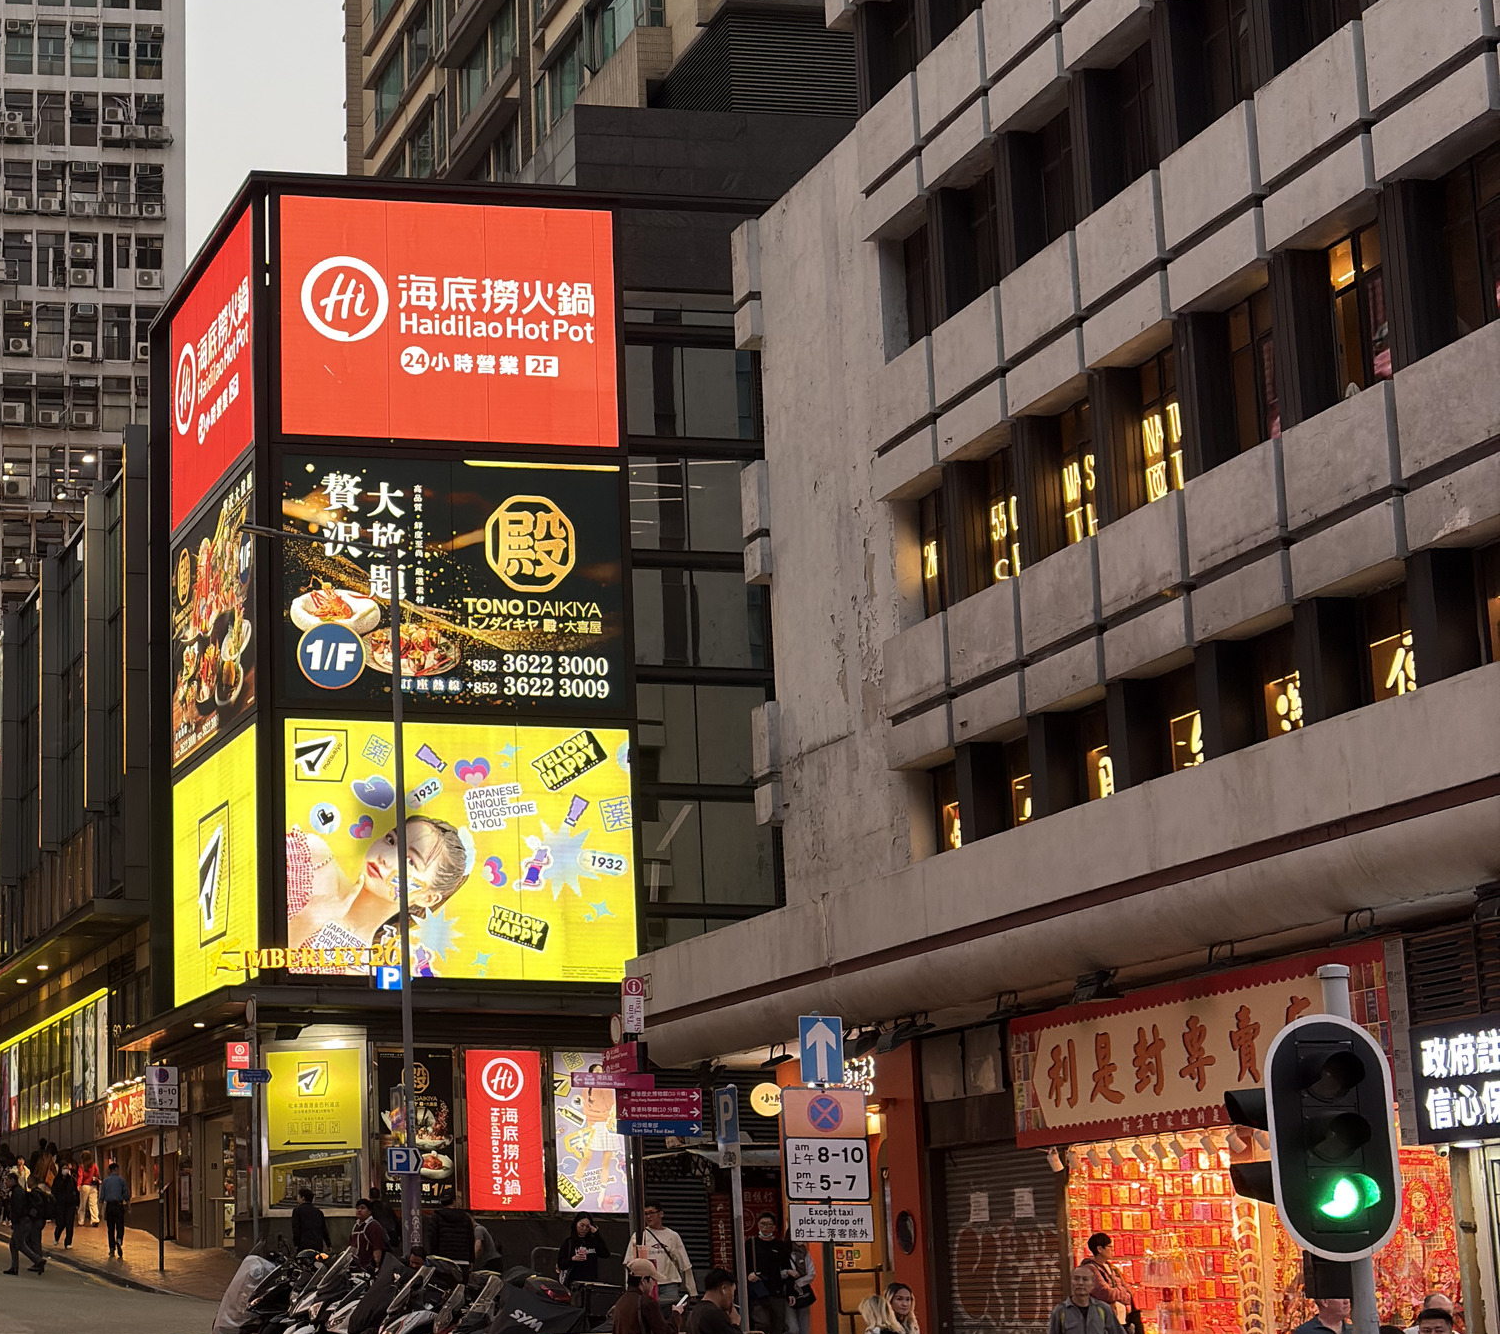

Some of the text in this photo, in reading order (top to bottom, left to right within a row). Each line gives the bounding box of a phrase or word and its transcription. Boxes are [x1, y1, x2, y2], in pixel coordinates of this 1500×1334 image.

[398, 274, 595, 318] 海底撈火鍋
[197, 275, 249, 378] 海底撈火鍋
[400, 313, 595, 344] Haidilao Hot Pot
[197, 323, 249, 405] Haidilao Pot
[531, 358, 553, 373] 2F
[463, 598, 603, 618] TONO DAIKIYA
[467, 618, 539, 631] トノダイキヤ
[305, 639, 357, 671] 1/F
[503, 653, 554, 674] 3622
[558, 655, 609, 677] 3000
[503, 676, 554, 697] 3622
[558, 678, 610, 699] 3009
[532, 731, 588, 773] YELLOW
[540, 744, 599, 788] HAPPY
[414, 781, 439, 802] 1932
[466, 785, 520, 801] JAPANESE
[467, 797, 508, 811] UNIQUE
[470, 803, 534, 820] DRUGSTORE
[471, 820, 478, 830] 4
[591, 855, 623, 871] 1932
[493, 906, 547, 932] YELLOW
[489, 919, 544, 945] HAPPY
[210, 938, 365, 976] KIMBERLEY
[369, 937, 401, 966] 26
[383, 968, 400, 989] P
[634, 997, 642, 1033] Sha Tsui
[158, 1088, 177, 1096] 8-10
[719, 1094, 734, 1138] P
[490, 1107, 503, 1195] Haidilao Hot Pot
[502, 1107, 521, 1196] 海底撈火鍋
[791, 1146, 864, 1165] 上午 8-10
[795, 1143, 810, 1151] am
[393, 1151, 406, 1168] P
[796, 1171, 812, 1180] pm
[792, 1181, 817, 1194] 下午
[502, 1196, 512, 1205] 2F
[799, 1217, 864, 1228] pick up/drop off
[808, 1207, 854, 1218] Except taxi
[795, 1227, 870, 1240] 的士上落客除外
[509, 1308, 544, 1333] SYM
